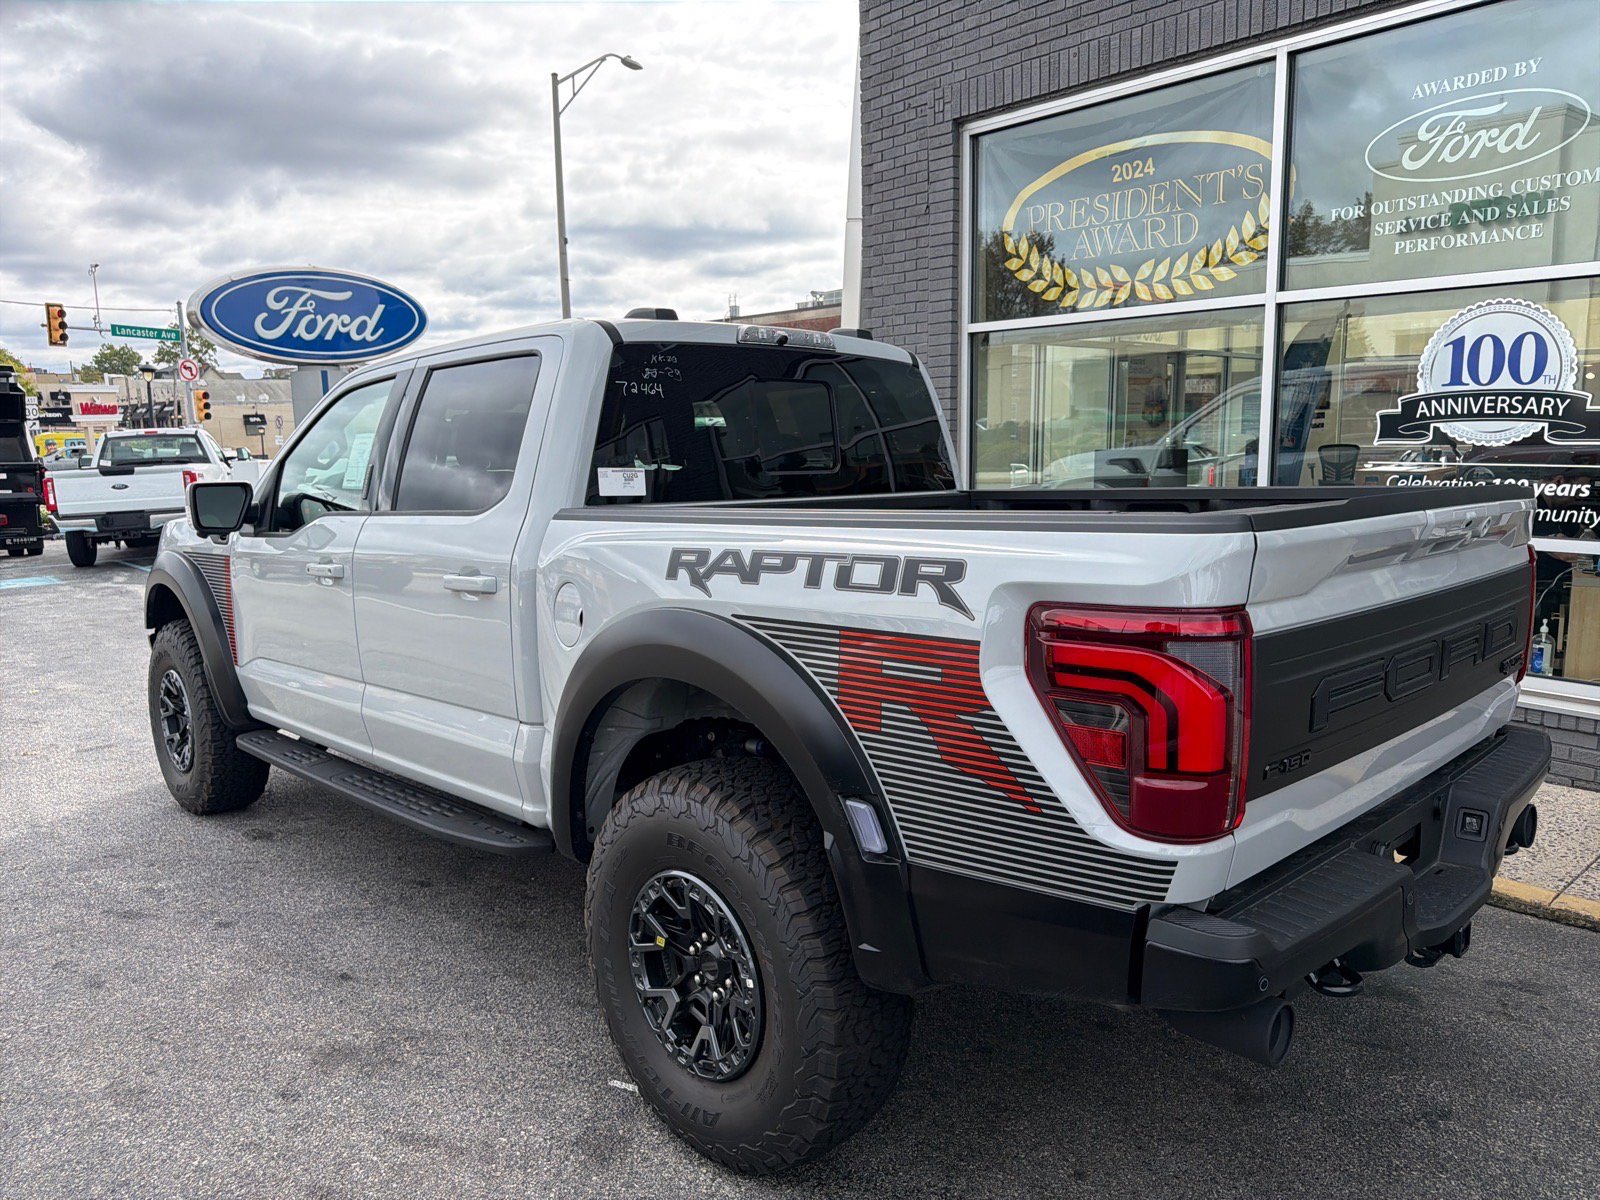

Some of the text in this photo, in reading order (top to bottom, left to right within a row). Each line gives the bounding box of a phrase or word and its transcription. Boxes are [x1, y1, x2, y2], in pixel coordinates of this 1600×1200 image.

[1412, 57, 1542, 99] AWARDED BY
[1401, 101, 1542, 170] Ford
[1111, 157, 1155, 182] 2024
[1025, 163, 1264, 235] PRESIDENT'S
[1331, 205, 1365, 221] FOR
[1370, 183, 1503, 216] OUTSTANDING
[1374, 196, 1571, 237] SERVICE AND SALES
[1069, 212, 1199, 260] AWARD
[1394, 223, 1544, 255] PERFORMANCE
[116, 326, 176, 339] Lancaster Ave
[254, 286, 386, 342] Ford
[1441, 331, 1556, 387] 100 TH
[80, 402, 118, 415] Wawa
[615, 380, 664, 398] 72464
[1416, 396, 1571, 418] ANNIVERSARY
[1533, 481, 1591, 497] years
[665, 547, 975, 621] RAPTOR
[1309, 615, 1516, 733] FORD
[1262, 748, 1312, 781] F-150
